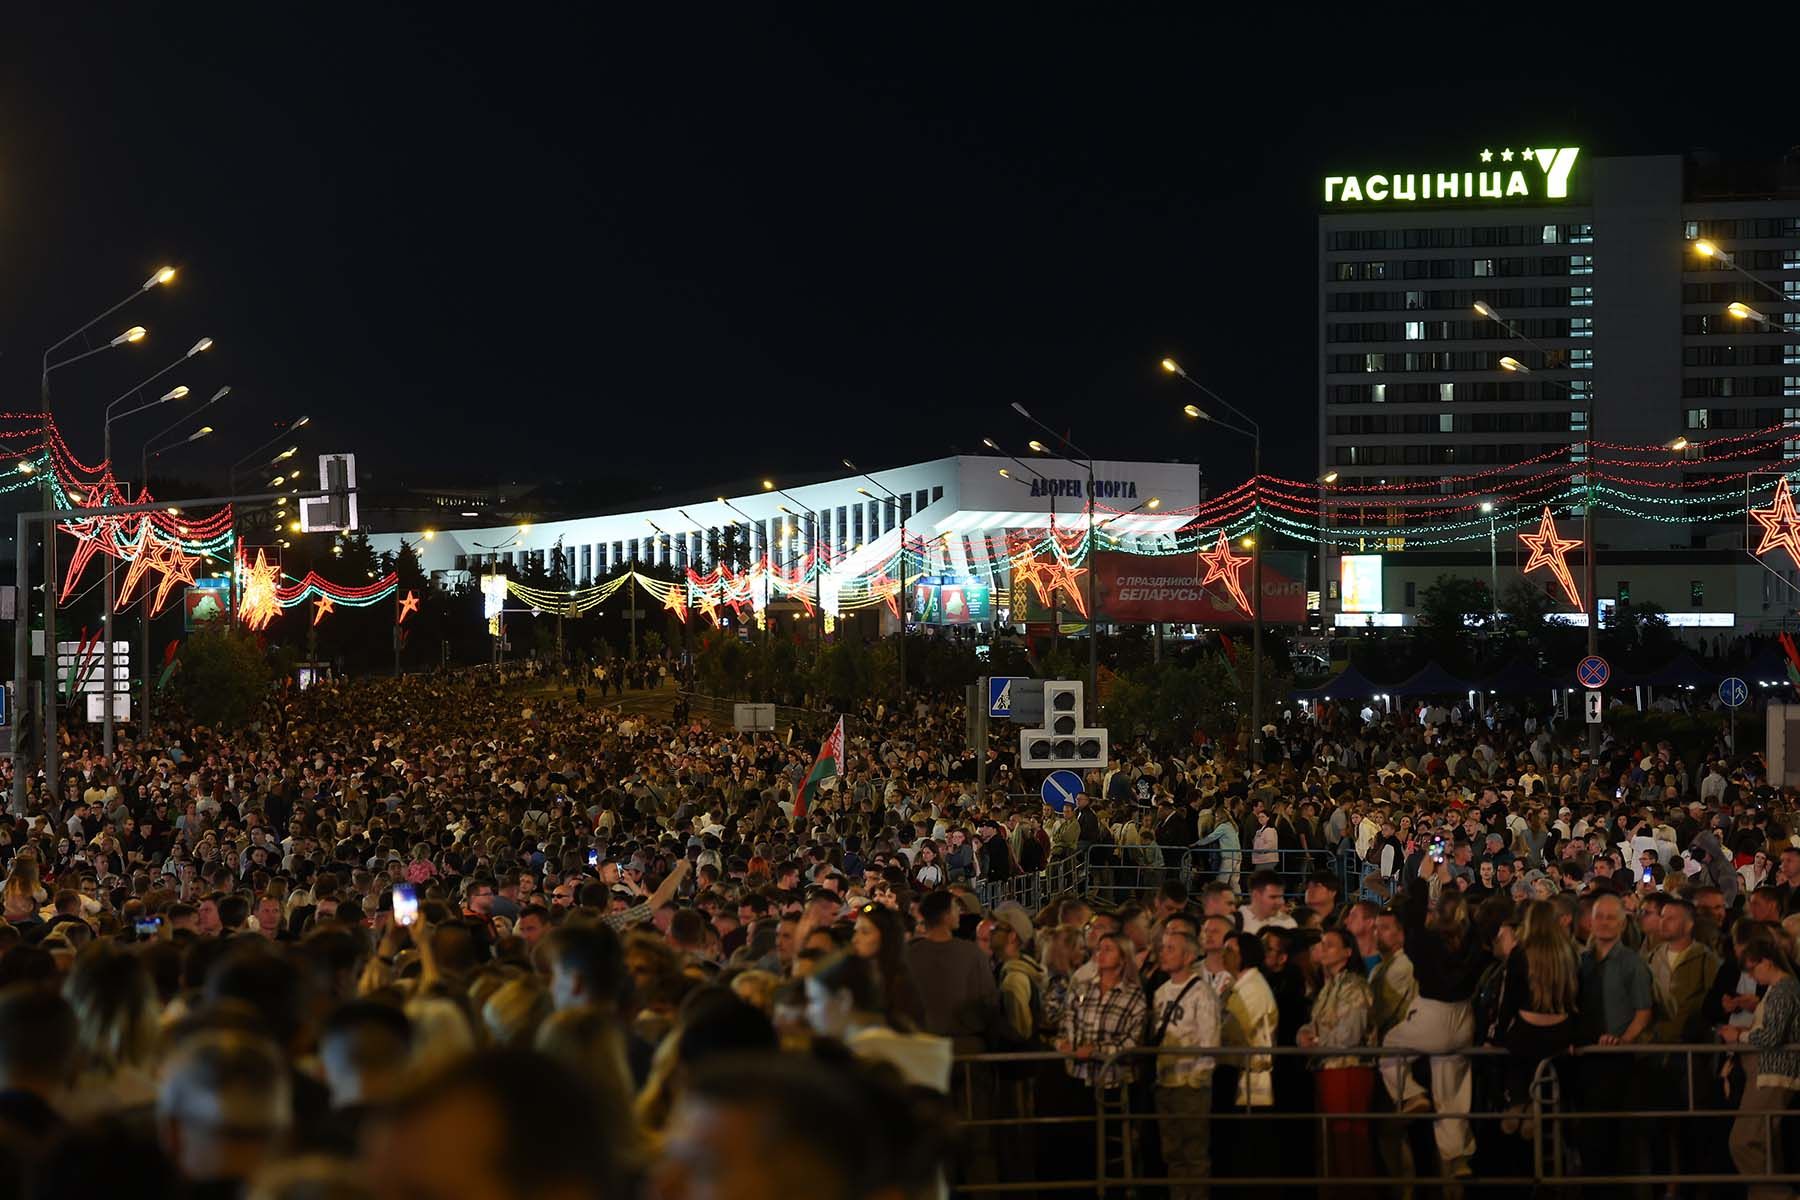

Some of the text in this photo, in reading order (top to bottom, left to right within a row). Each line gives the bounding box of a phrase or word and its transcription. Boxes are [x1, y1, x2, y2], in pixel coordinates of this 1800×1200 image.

[1325, 171, 1529, 202] ГАСЦІНІЦА
[1030, 479, 1083, 498] ДВОРЕЦ
[1116, 577, 1203, 587] С ПРАЗДНИКОМ
[1119, 588, 1205, 601] БЕЛАРУСЬ!
